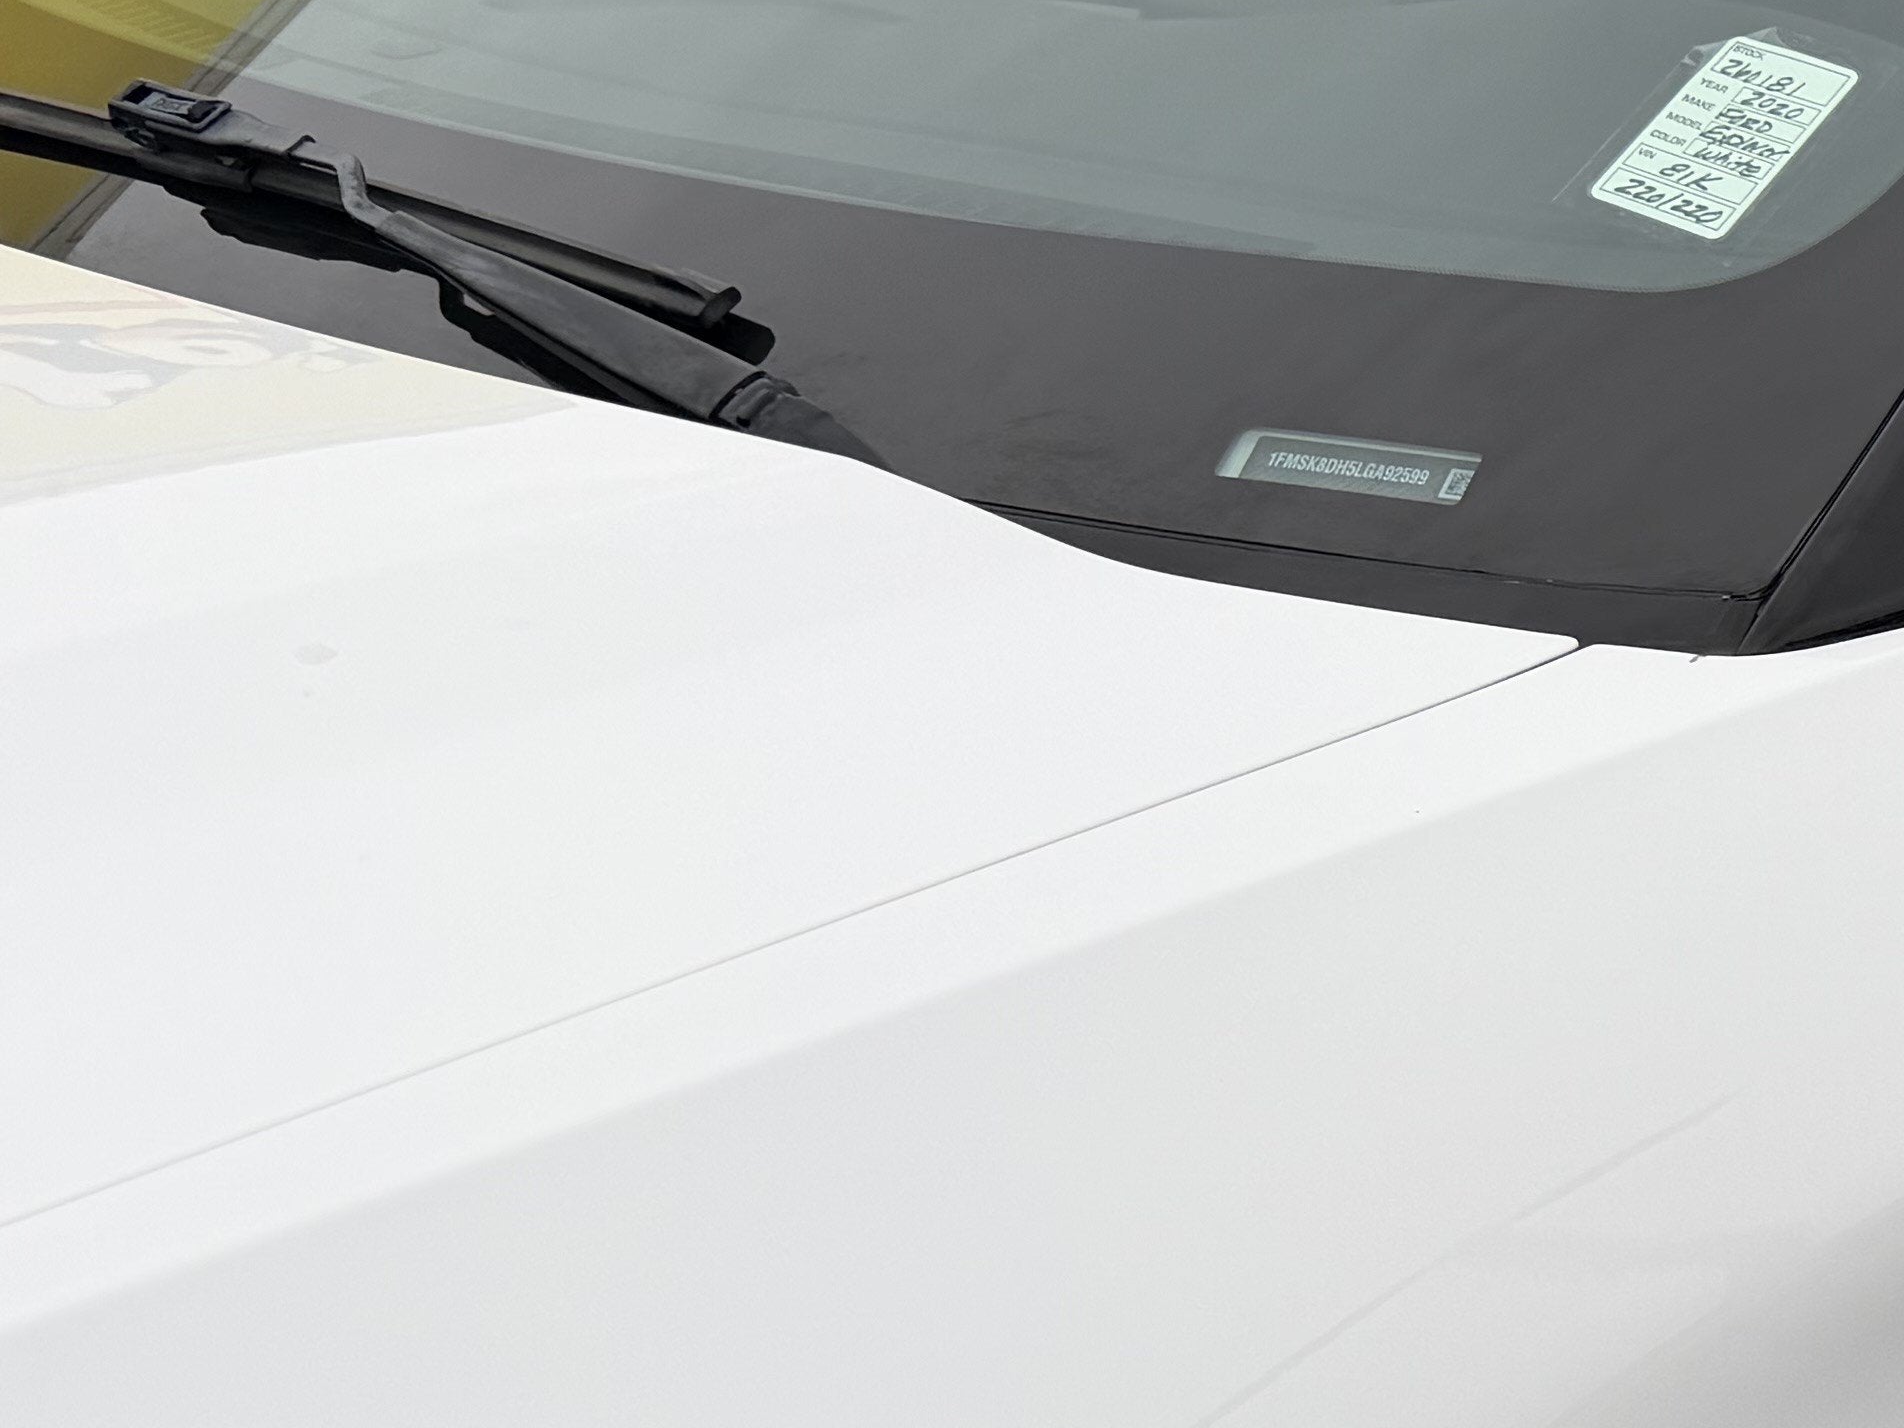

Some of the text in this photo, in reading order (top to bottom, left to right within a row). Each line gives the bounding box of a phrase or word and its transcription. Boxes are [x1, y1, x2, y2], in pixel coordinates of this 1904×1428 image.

[1699, 77, 1729, 94] YEAR
[1680, 93, 1716, 112] MAKE
[1740, 90, 1804, 120] 2020
[1665, 111, 1703, 131] MODEL
[1649, 128, 1687, 148] COLOR
[1613, 178, 1724, 224] 220/220
